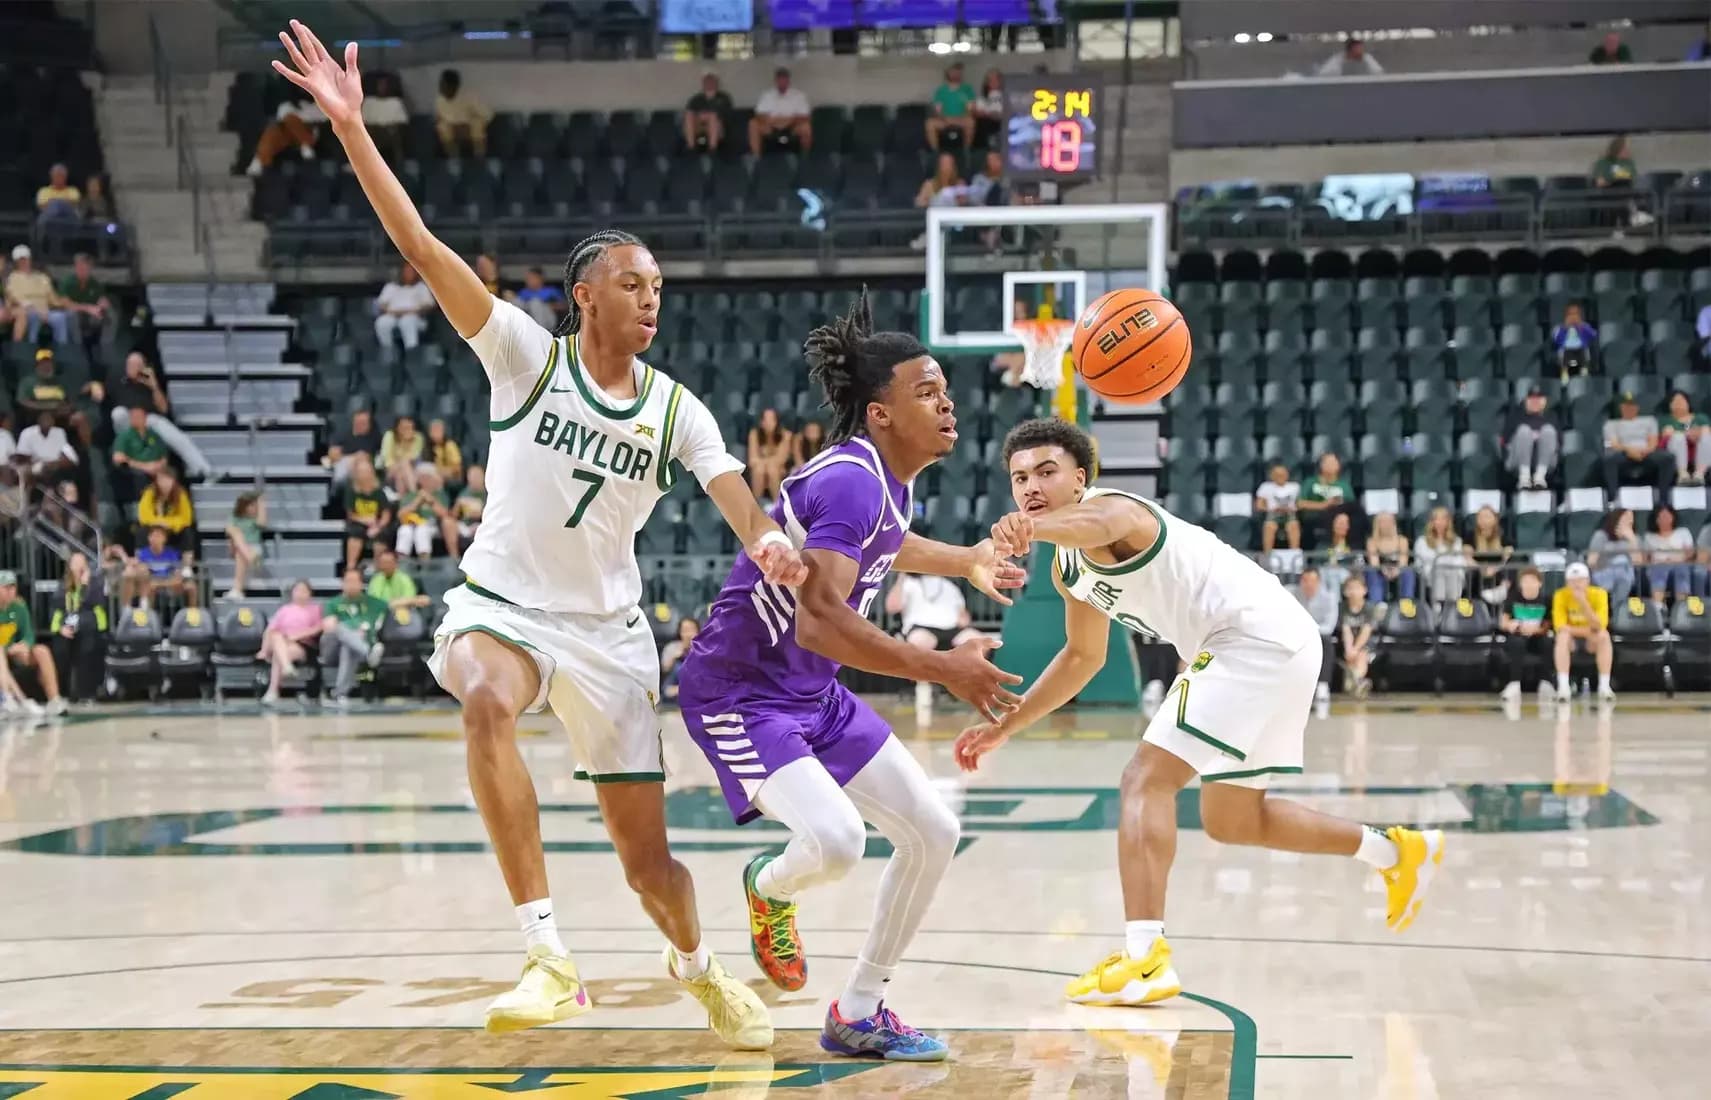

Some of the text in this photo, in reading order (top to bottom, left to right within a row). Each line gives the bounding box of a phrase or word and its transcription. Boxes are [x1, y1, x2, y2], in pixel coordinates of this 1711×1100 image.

[1031, 89, 1091, 120] 2:14
[1041, 121, 1082, 172] 18
[1096, 308, 1158, 355] ELITE
[534, 410, 653, 482] BAYLOR
[564, 468, 606, 528] 7
[1085, 580, 1123, 611] LOR
